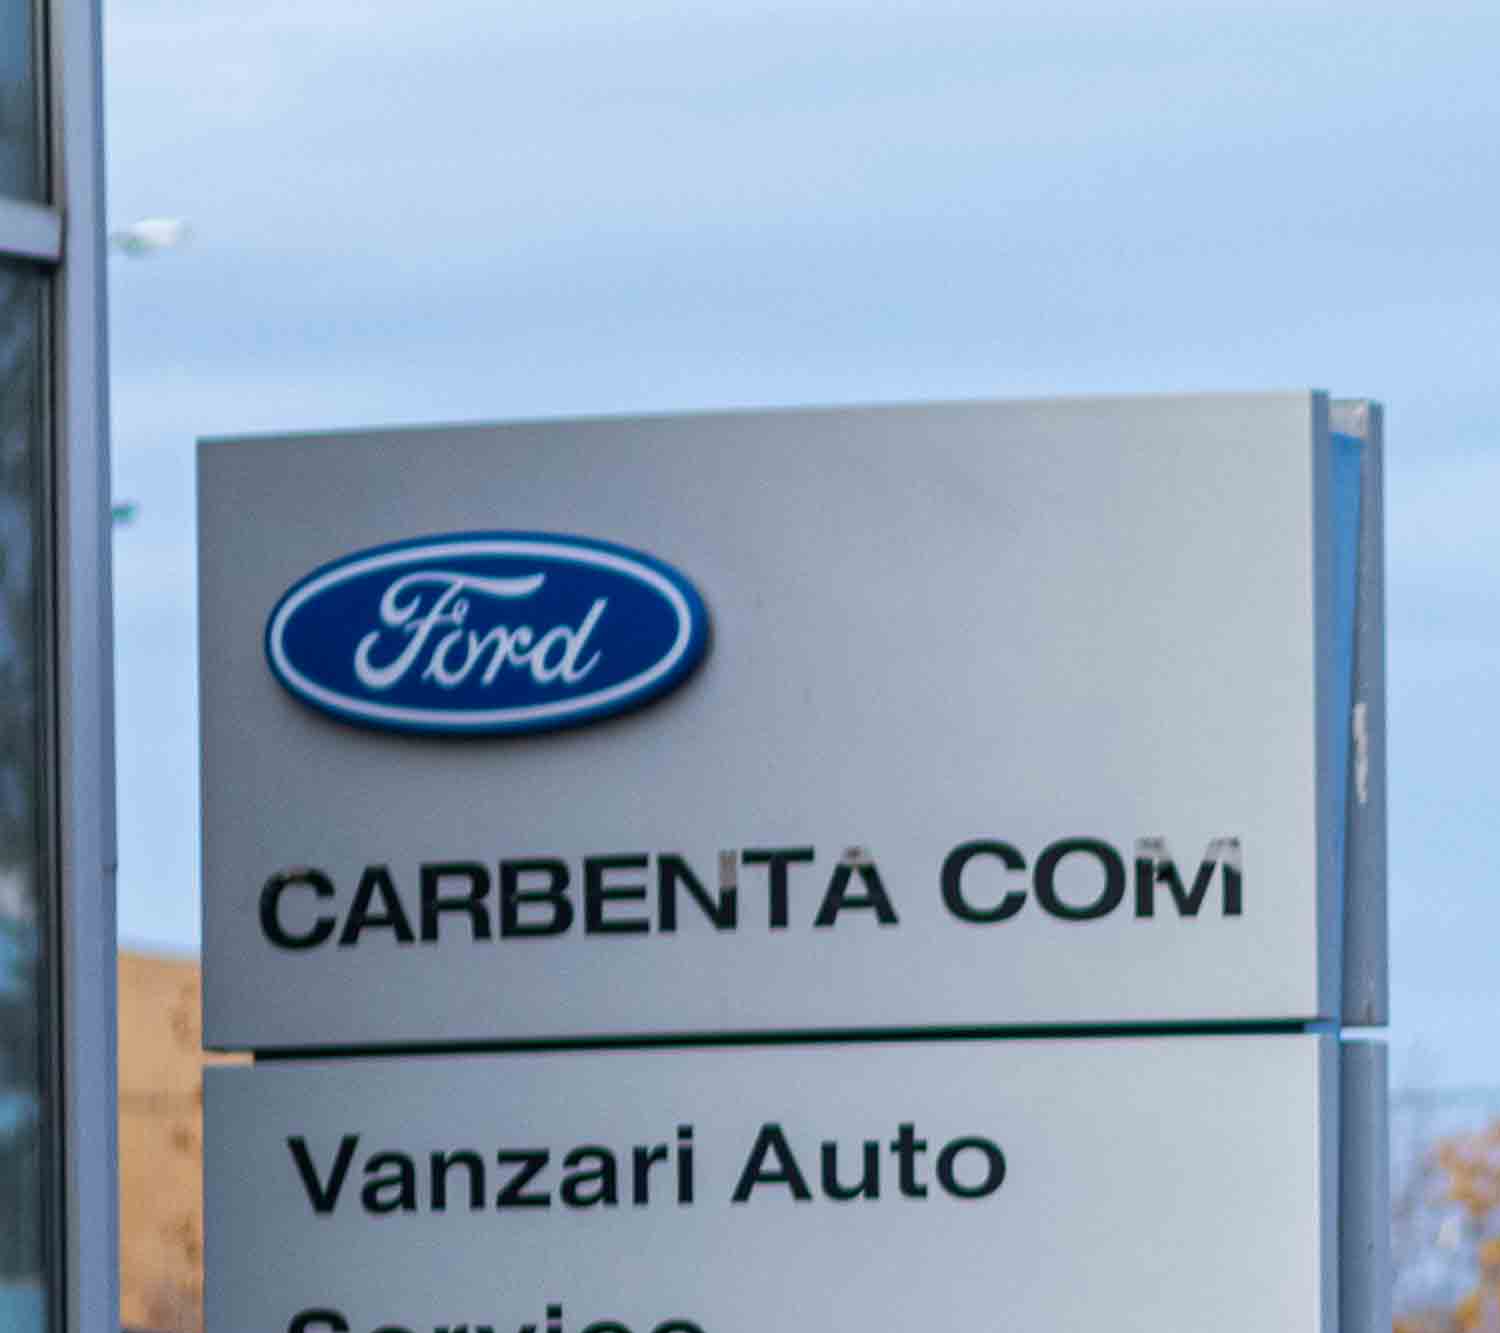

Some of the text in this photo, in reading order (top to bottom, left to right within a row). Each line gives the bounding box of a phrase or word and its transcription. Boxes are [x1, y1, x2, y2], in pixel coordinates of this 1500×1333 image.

[352, 568, 604, 693] Ford
[257, 838, 1244, 954] CARBENTA COM
[285, 1123, 1007, 1216] Vanzari Auto
